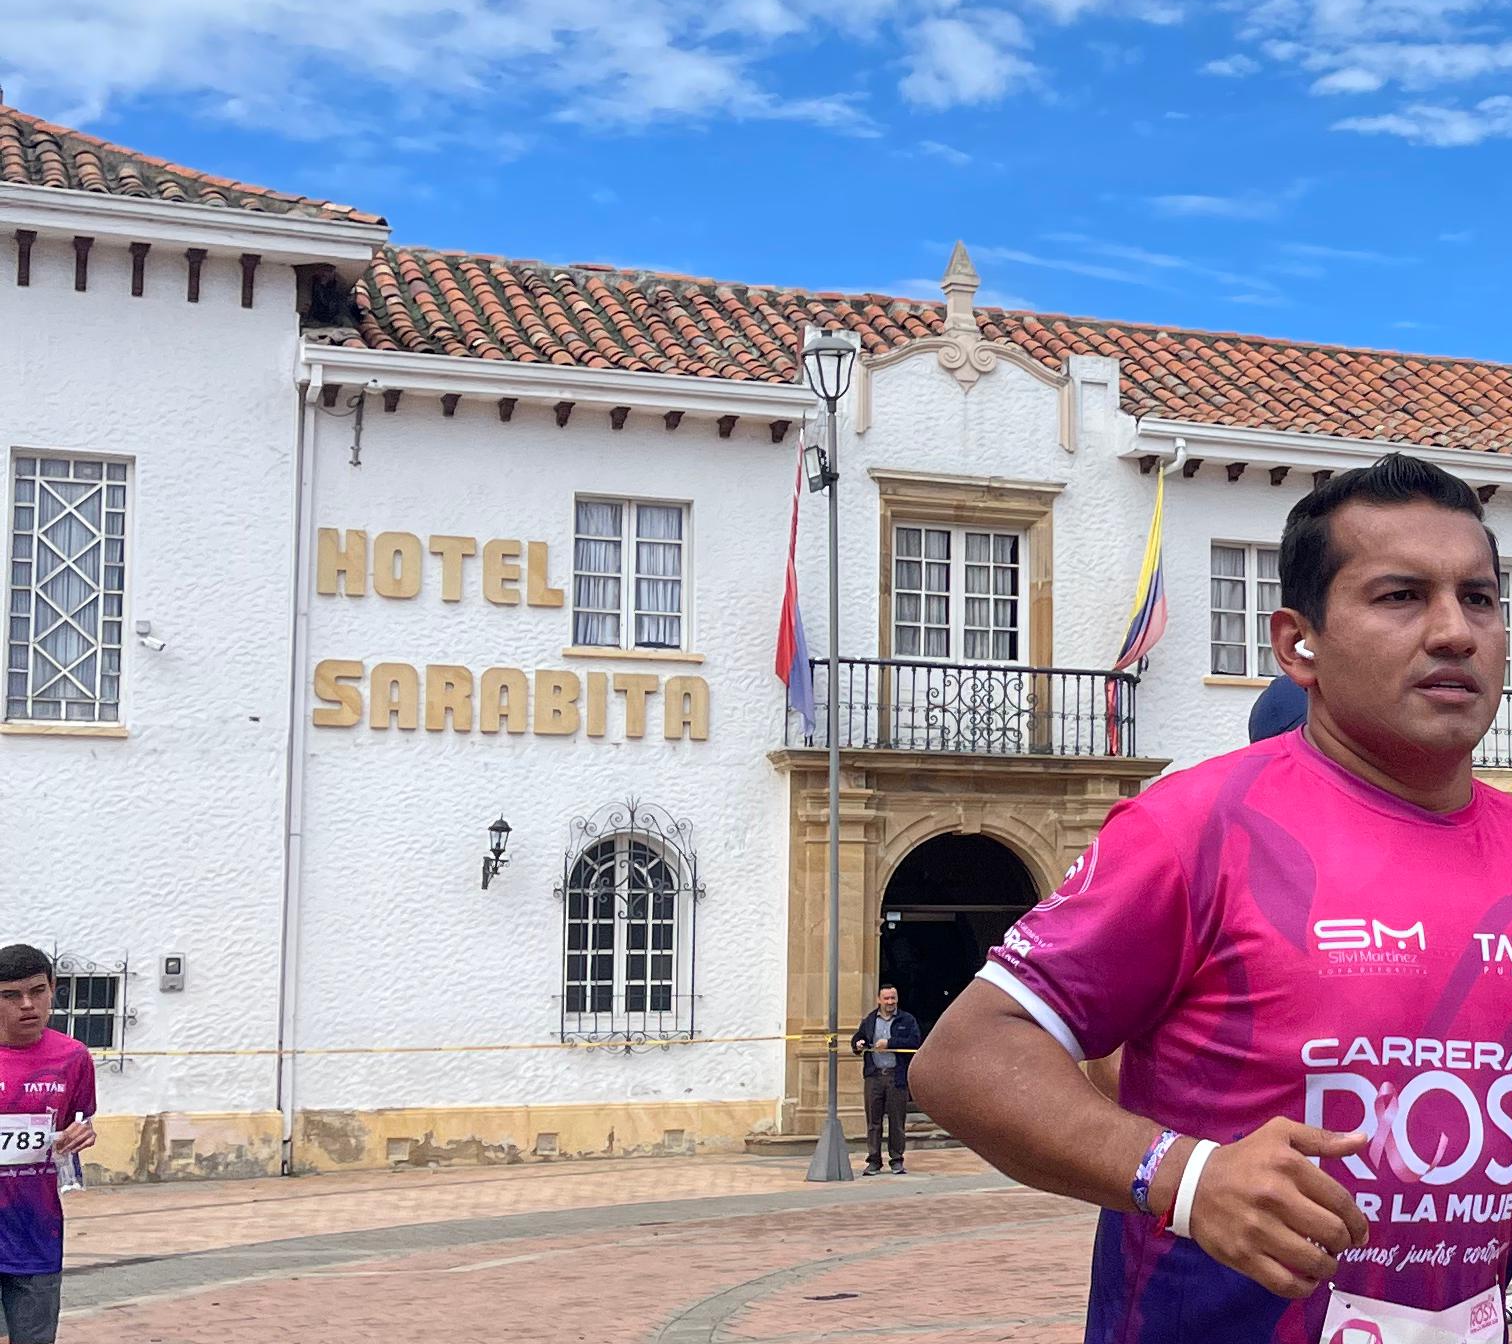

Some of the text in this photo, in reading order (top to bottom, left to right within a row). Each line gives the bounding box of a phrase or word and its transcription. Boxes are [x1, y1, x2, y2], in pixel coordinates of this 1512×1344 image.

[317, 527, 565, 607] HOTEL
[312, 659, 710, 741] SARABITA
[1313, 919, 1427, 951] SM
[1, 1131, 46, 1150] 783
[1391, 1194, 1438, 1223] LA
[1395, 1240, 1457, 1272] juntos
